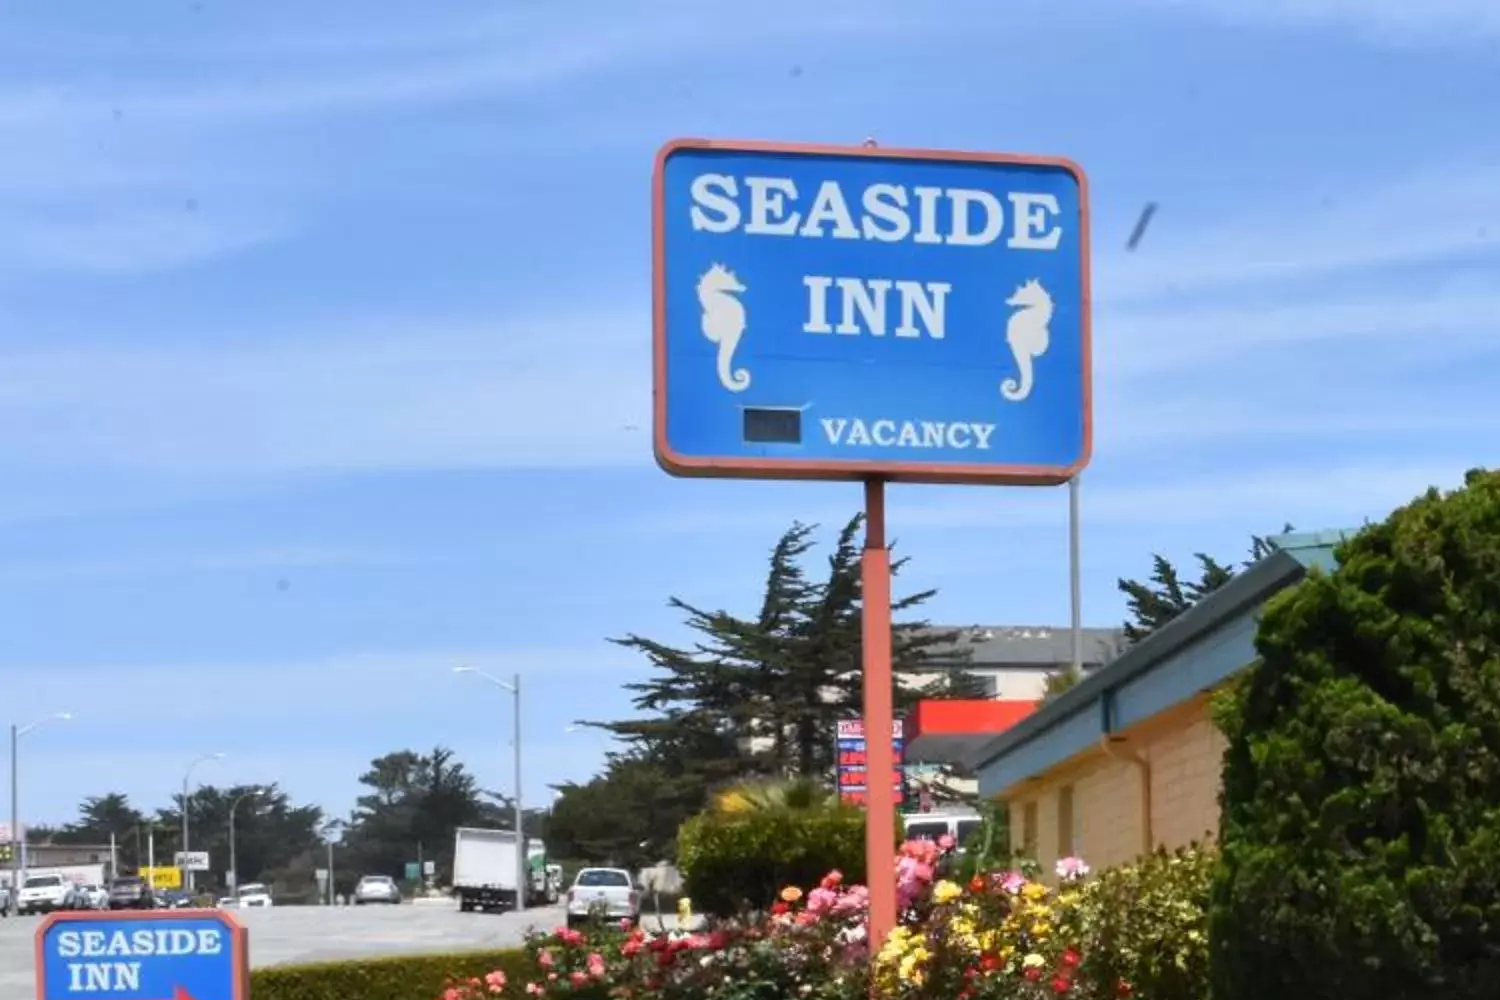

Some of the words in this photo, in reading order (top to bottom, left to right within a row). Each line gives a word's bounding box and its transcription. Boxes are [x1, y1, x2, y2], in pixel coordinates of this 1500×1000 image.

[689, 173, 1062, 250] SEASIDE
[802, 275, 952, 339] INN
[820, 418, 996, 449] VACANCY
[57, 928, 222, 957] SEASIDE
[68, 962, 142, 991] INN
